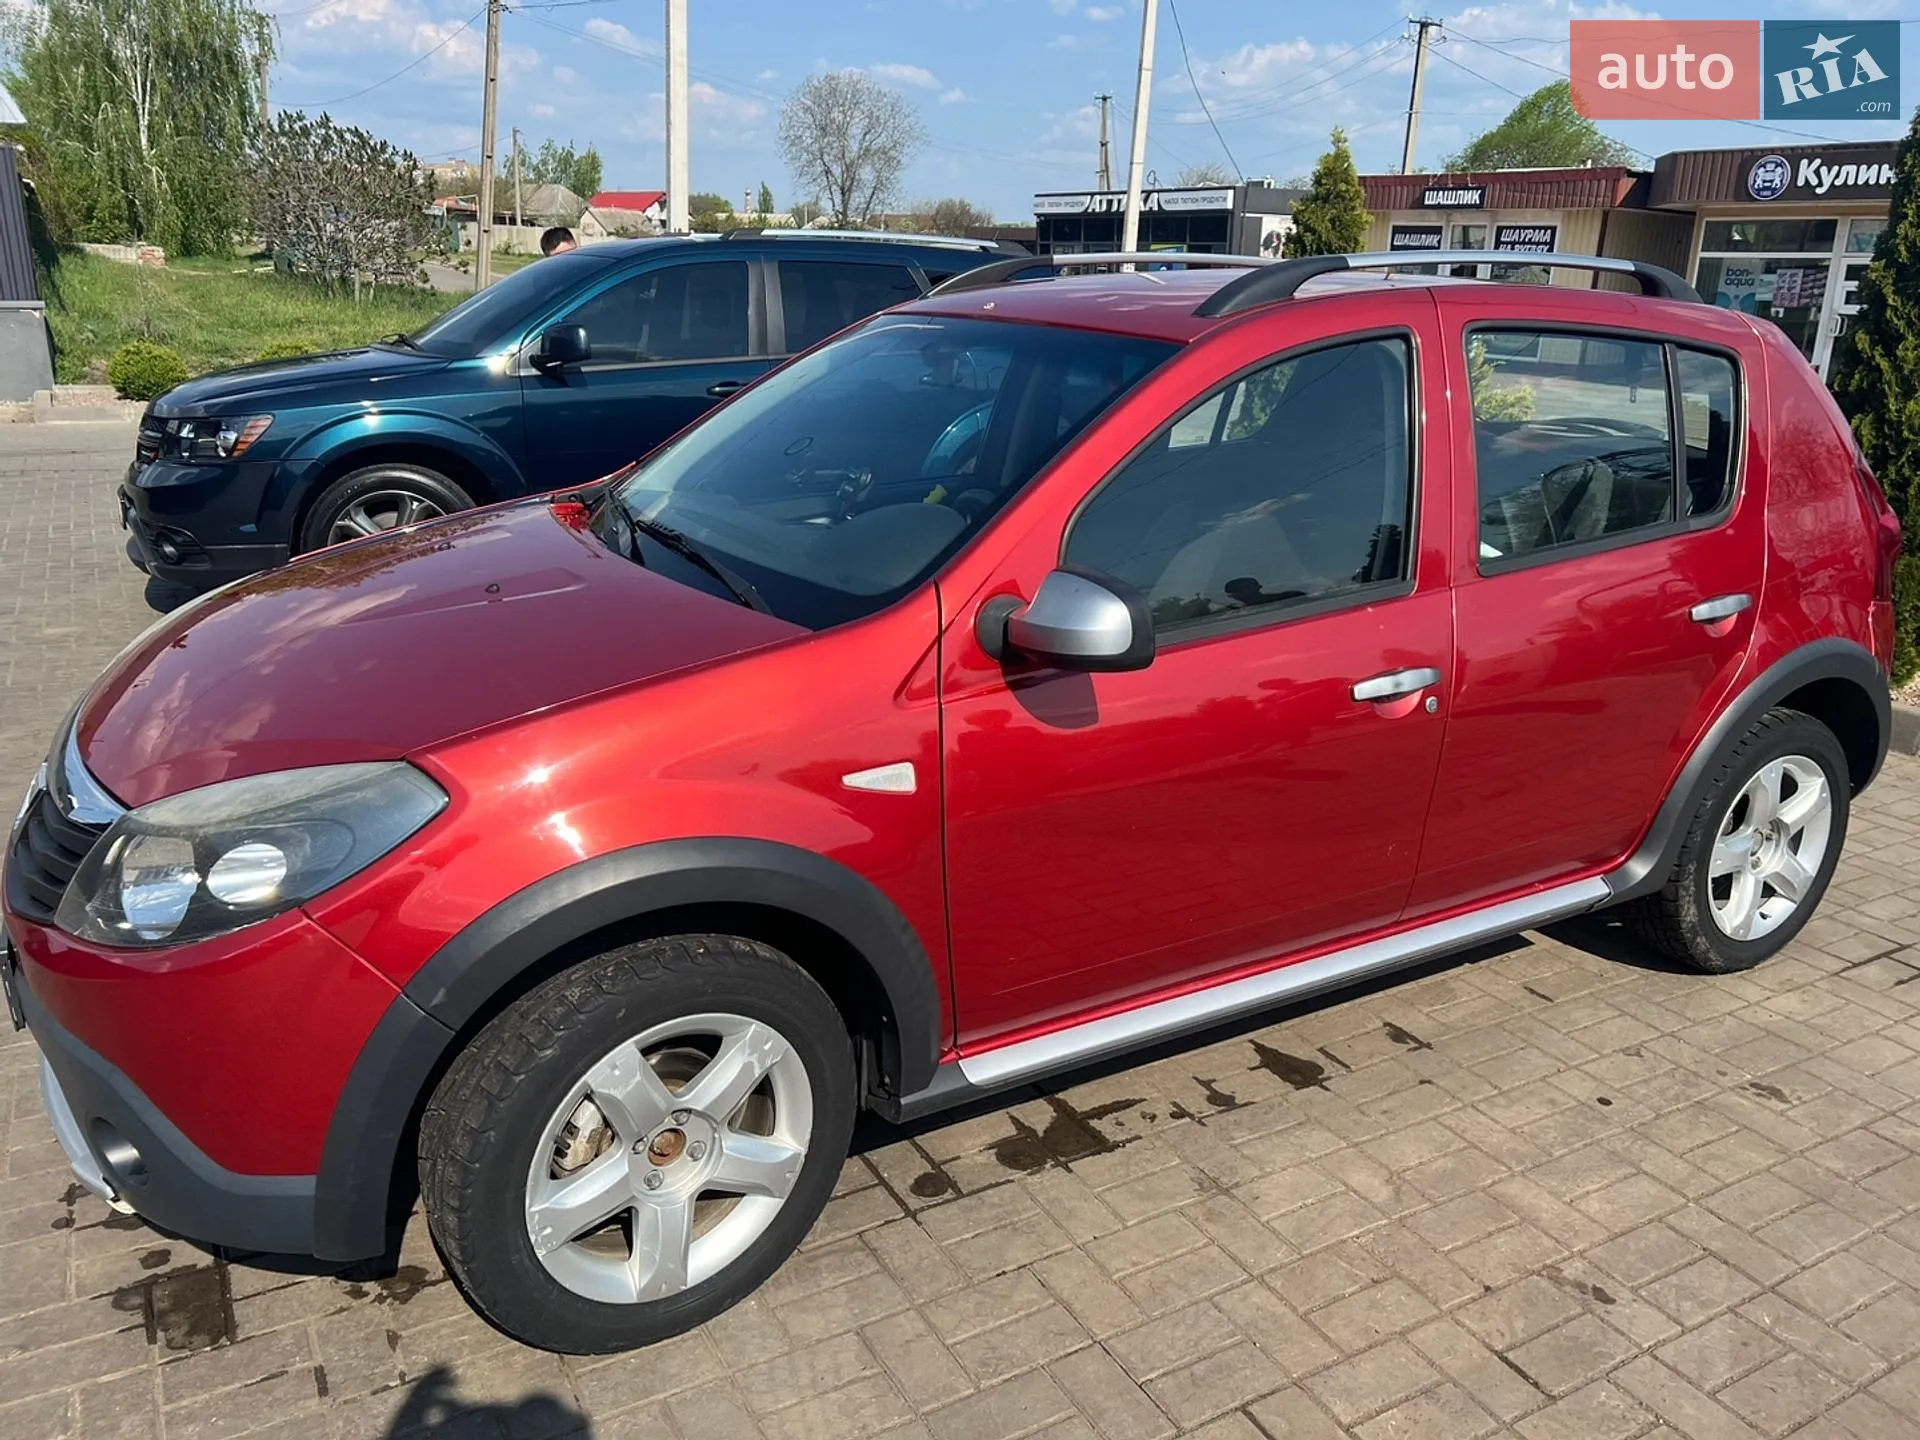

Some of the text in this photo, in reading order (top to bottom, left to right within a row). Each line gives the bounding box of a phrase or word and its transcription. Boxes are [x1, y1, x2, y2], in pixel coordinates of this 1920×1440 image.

[1424, 189, 1482, 205] ШАШЛИК
[1393, 233, 1441, 247] ШАШЛИК
[1500, 229, 1551, 243] ШАУРМА
[1725, 277, 1755, 288] aqua
